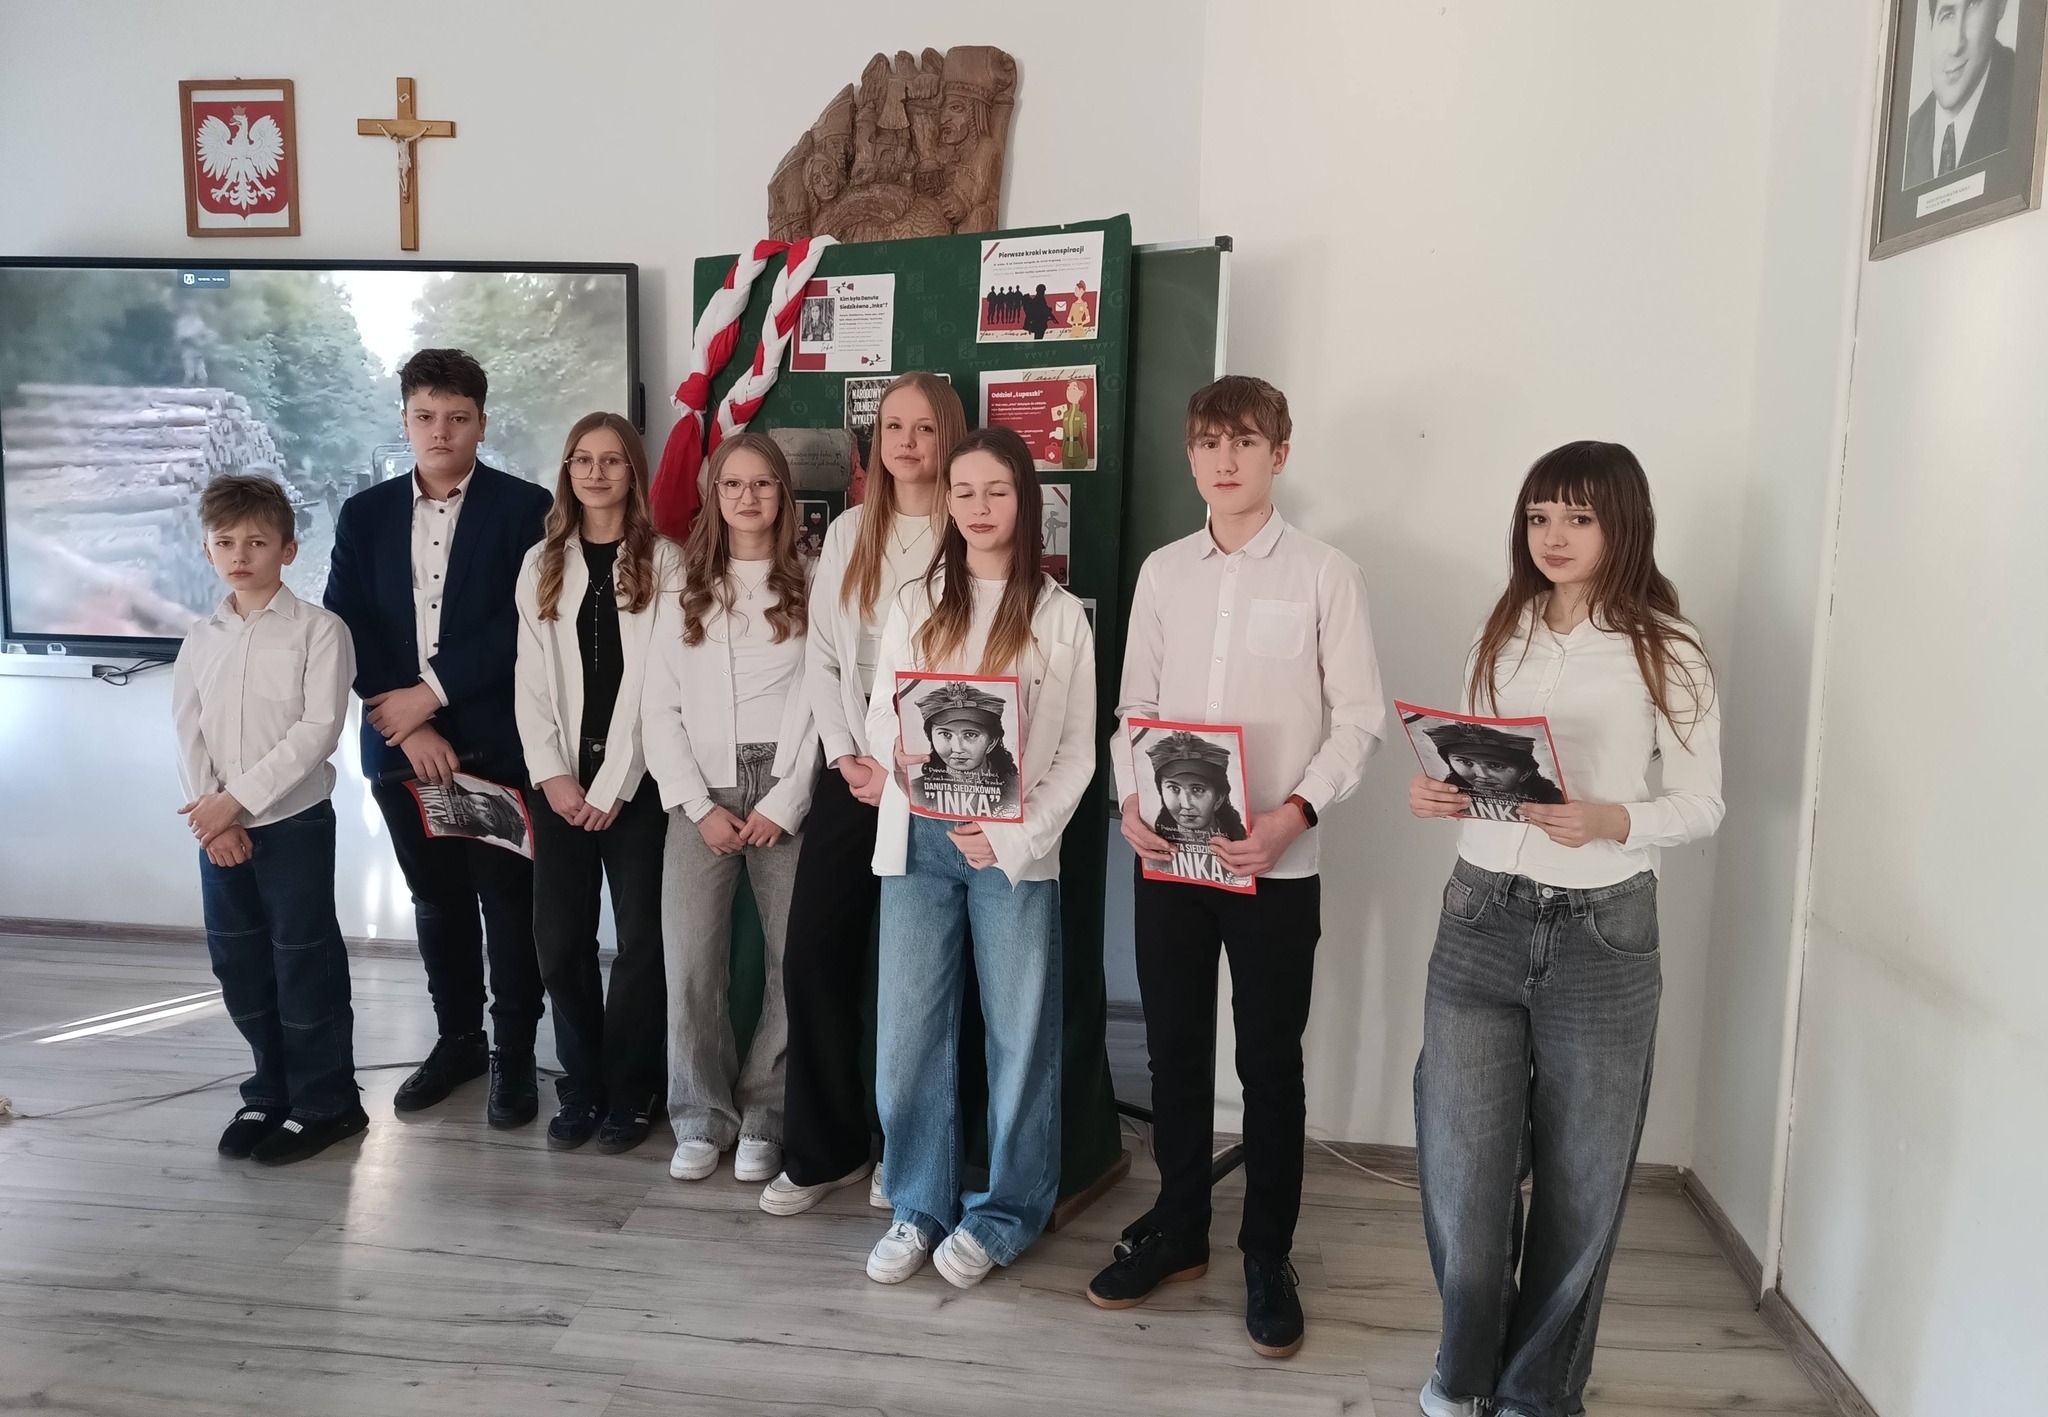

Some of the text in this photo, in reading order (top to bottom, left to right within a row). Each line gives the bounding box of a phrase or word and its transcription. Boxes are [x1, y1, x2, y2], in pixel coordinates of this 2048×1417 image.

[999, 250, 1025, 258] Pierwsze
[1025, 248, 1042, 257] kroki
[1048, 245, 1084, 255] konspiracji
[924, 782, 1001, 795] DANUTA SIEDZIKÓWNA
[1485, 798, 1520, 807] SIEDZIK
[282, 1119, 304, 1134] UMA
